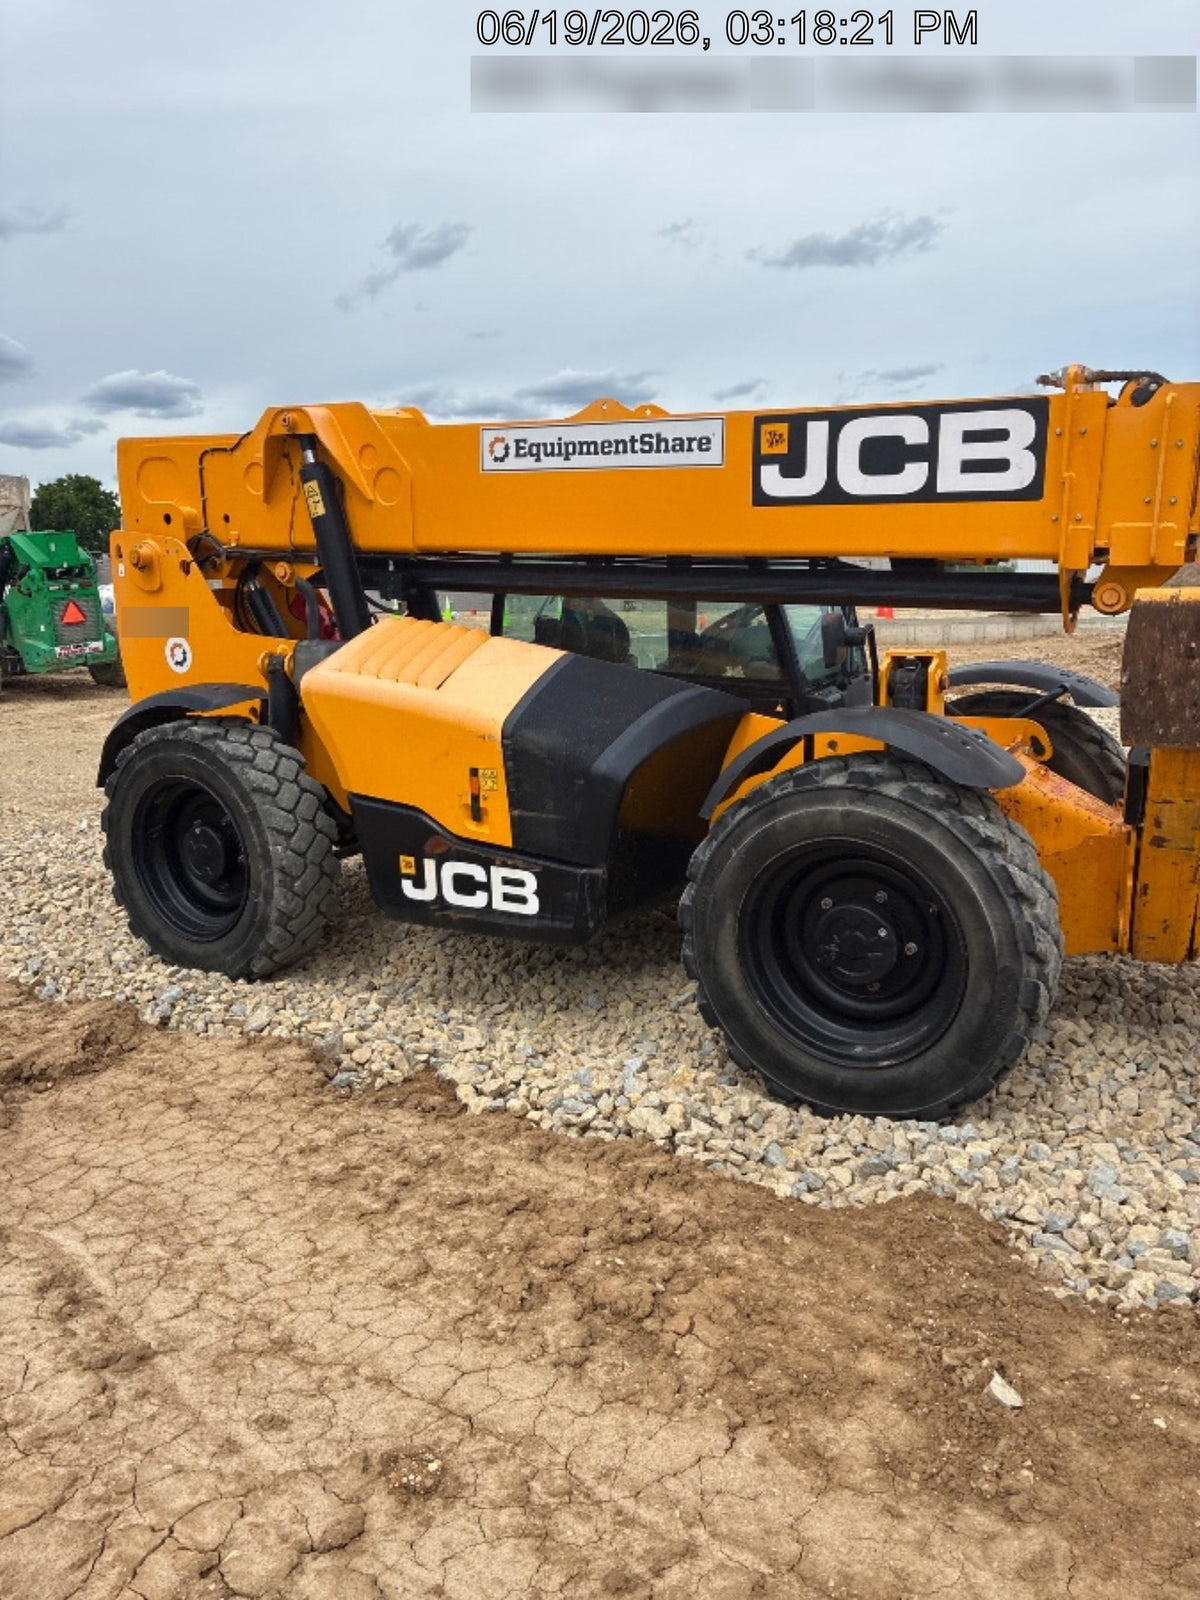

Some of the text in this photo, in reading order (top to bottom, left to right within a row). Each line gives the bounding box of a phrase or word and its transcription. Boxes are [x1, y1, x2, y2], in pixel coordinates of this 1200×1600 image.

[513, 432, 712, 463] EquipmentShare
[760, 408, 1037, 497] JCB
[401, 857, 540, 915] JCB
